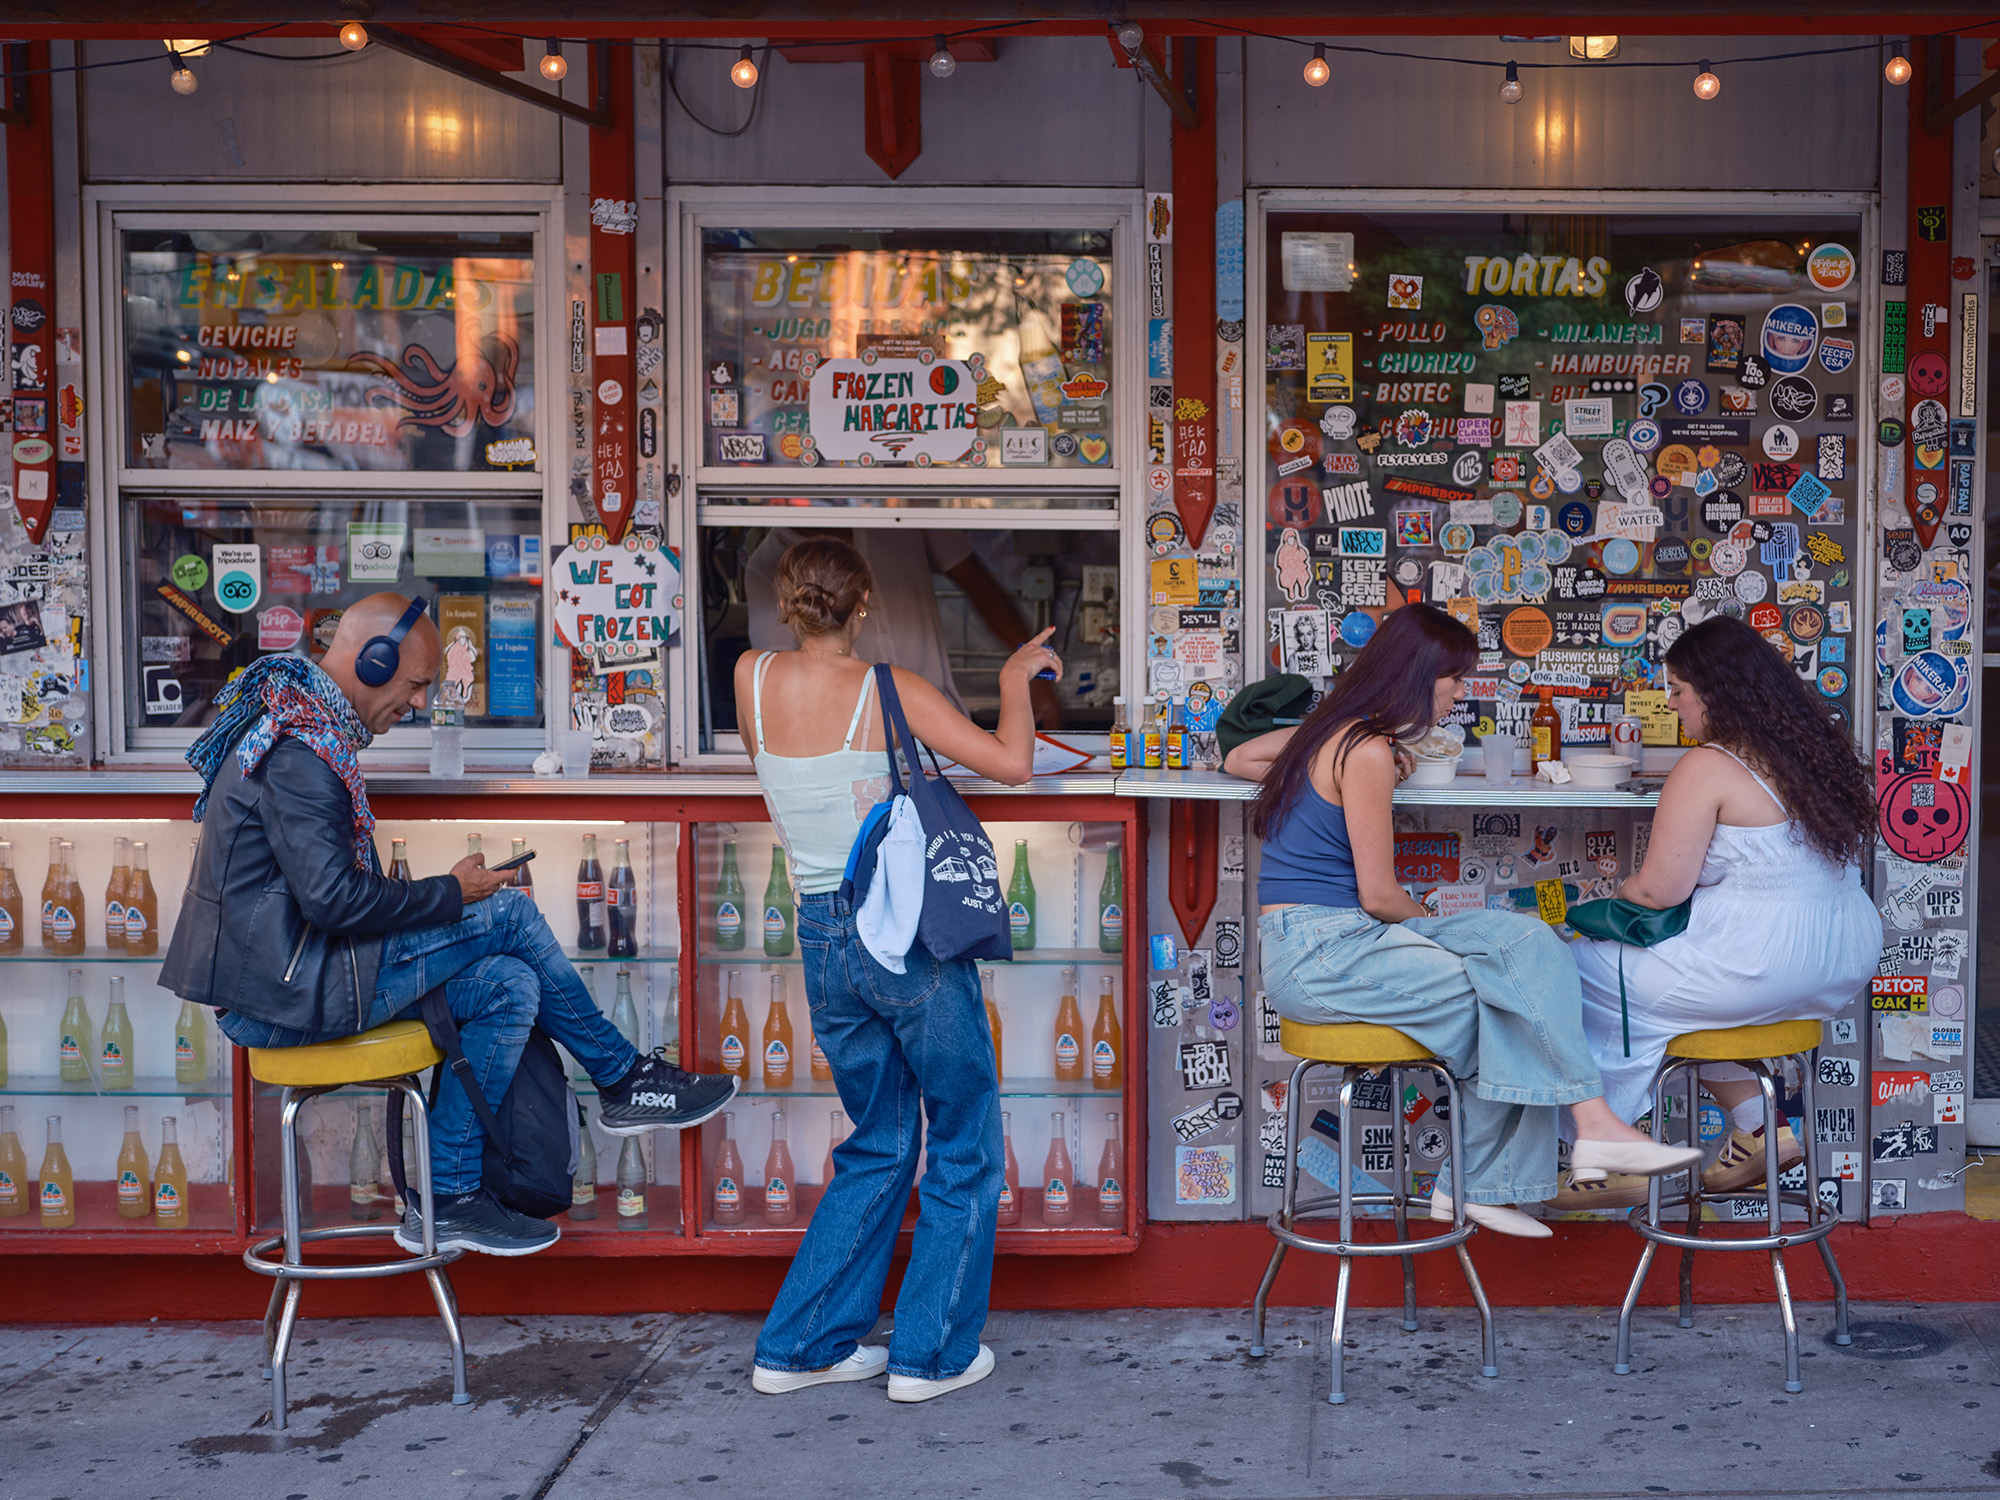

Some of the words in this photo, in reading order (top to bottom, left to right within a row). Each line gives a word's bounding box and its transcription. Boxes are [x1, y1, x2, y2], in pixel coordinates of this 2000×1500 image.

[1813, 258, 1837, 269] Free
[1838, 259, 1850, 269] &
[1464, 255, 1611, 298] TORTAS
[1818, 267, 1847, 279] Easy
[179, 261, 494, 311] ENSALADAS
[752, 261, 978, 307] BEBIDAS
[767, 318, 845, 341] JUGOS
[1378, 321, 1446, 343] POLLO
[1551, 323, 1663, 344] MILANESA
[198, 325, 298, 350] CEVICHE
[1883, 302, 1893, 373] PLEASURES
[1890, 302, 1900, 373] PLEASURES
[1897, 302, 1907, 373] PLEASURES
[1821, 348, 1852, 360] ZECER
[197, 358, 302, 379] NOPALES
[1222, 351, 1237, 373] RISE
[1377, 352, 1477, 375] CHORIZO
[1551, 354, 1692, 376] HAMBURGER
[1825, 356, 1844, 368] ESA
[832, 371, 914, 400] FROZEN
[1741, 375, 1765, 385] easy
[200, 389, 230, 411] DE
[238, 389, 264, 412] LA
[1376, 383, 1453, 405] BISTEC
[843, 402, 978, 432] MARGARITAS
[1574, 407, 1601, 416] STREET
[573, 392, 585, 449] FUKKATSU
[1459, 419, 1490, 429] OPEN
[200, 419, 259, 442] MAIZ
[1458, 428, 1490, 437] CLASS
[1178, 439, 1207, 457] TAD
[598, 460, 624, 478] TAD
[1959, 463, 1971, 487] RAP
[1322, 480, 1375, 525] PIXOTE
[1886, 531, 1912, 540] sean
[1950, 526, 1970, 539] AO
[217, 557, 256, 565] Tripadvisor
[354, 563, 398, 572] tripadvisor
[1341, 560, 1387, 572] KENZ
[568, 560, 613, 585] WE
[1341, 572, 1387, 584] BEL
[1556, 567, 1577, 577] NYC
[1200, 580, 1225, 588] HELLO
[1340, 583, 1387, 596] GENE
[1698, 577, 1727, 590] STAY
[615, 582, 657, 609] GOT
[1559, 588, 1576, 598] CO.
[1341, 595, 1386, 607] HSM
[493, 604, 532, 614] Citysearch
[1556, 612, 1574, 621] NON
[1577, 612, 1601, 621] FARE
[577, 613, 670, 642] FROZEN
[1556, 622, 1568, 630] IL
[1571, 622, 1601, 631] NADOR
[1540, 651, 1595, 662] BUSHWICK
[1598, 652, 1619, 664] HAS
[1550, 663, 1584, 675] YACHT
[1586, 664, 1619, 675] CLUB?
[1556, 674, 1588, 688] Daddy
[926, 835, 945, 860] WHEN
[960, 832, 974, 842] YOU
[962, 896, 983, 909] JUST
[1440, 892, 1459, 900] Hate
[1460, 891, 1478, 899] Your
[1926, 891, 1961, 905] DIPS
[1441, 899, 1483, 908] Restaurant
[1931, 905, 1957, 915] MTA
[1900, 936, 1934, 949] FUN
[1900, 948, 1934, 961] STUFF
[1872, 978, 1925, 993] DETOR
[1872, 996, 1909, 1010] GAK
[1932, 1032, 1961, 1041] OVER
[631, 1092, 676, 1109] HOKA
[1817, 1108, 1855, 1132] MUCH
